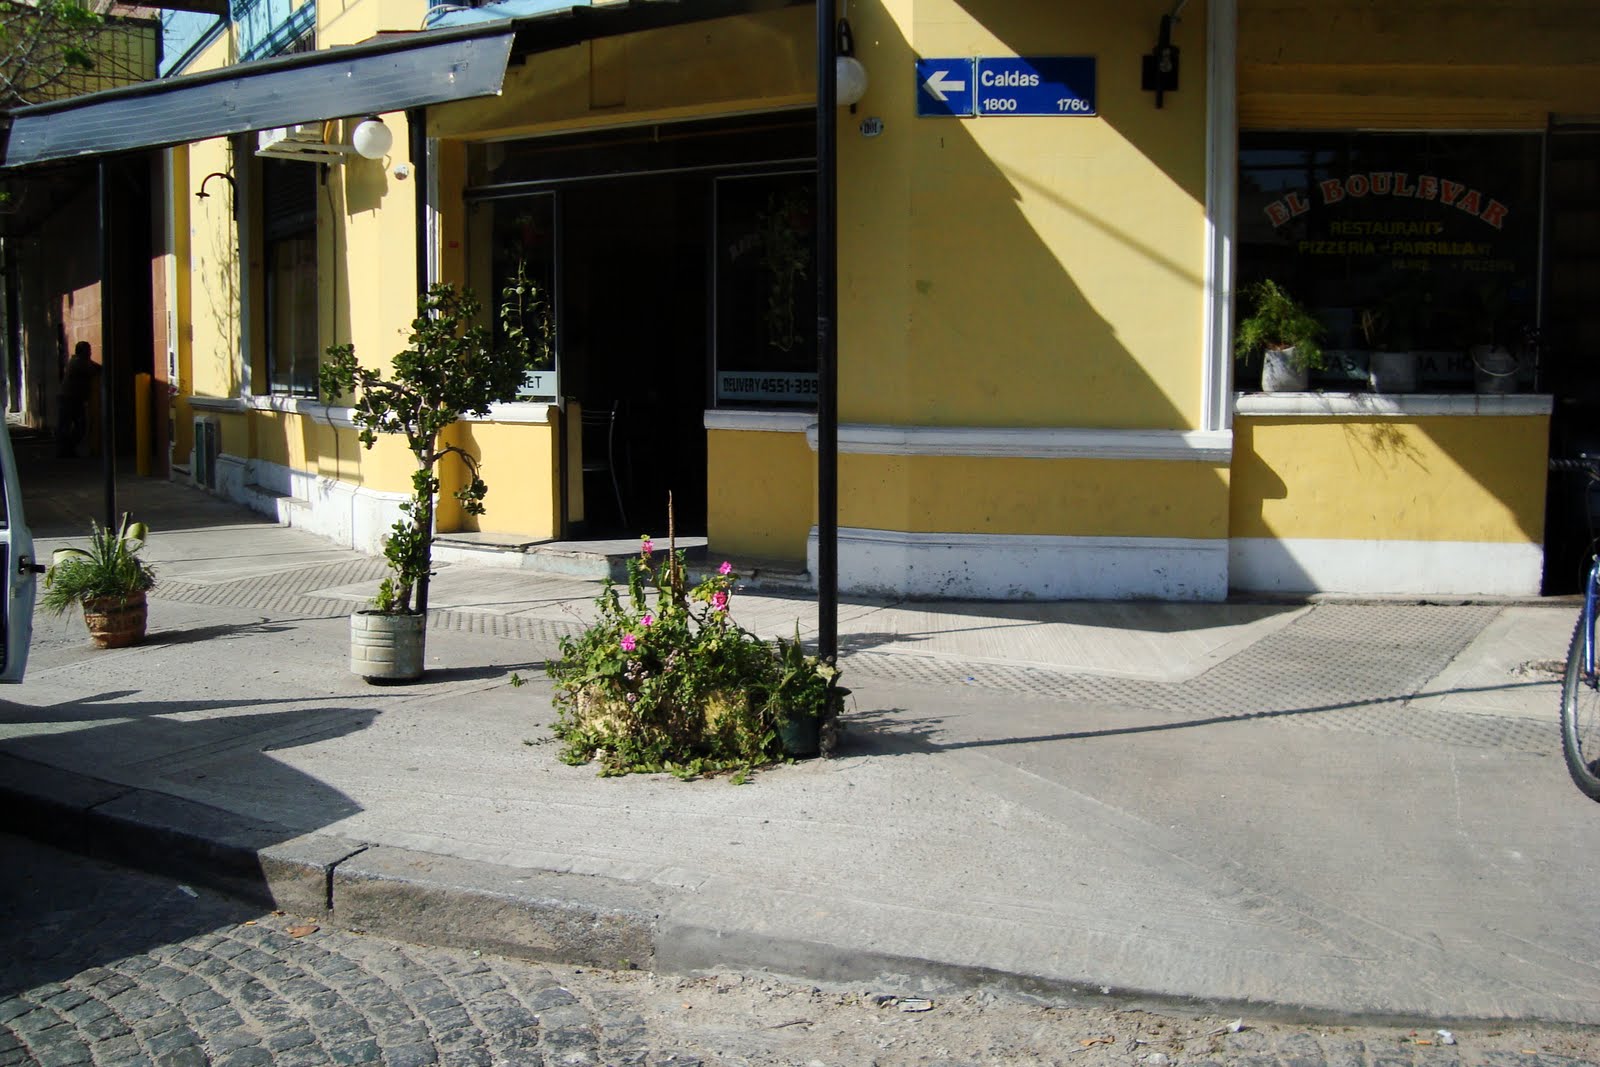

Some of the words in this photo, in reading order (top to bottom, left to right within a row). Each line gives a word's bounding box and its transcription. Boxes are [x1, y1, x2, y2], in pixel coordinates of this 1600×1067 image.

[981, 70, 1040, 87] Caldas
[983, 98, 1017, 111] 1800
[1057, 98, 1090, 111] 1760
[1263, 191, 1310, 228] EL
[1320, 171, 1510, 231] BOULEVAR
[1297, 240, 1375, 255] PIZZERIA
[1392, 241, 1474, 256] PARRILLA
[723, 377, 760, 393] DELIVERY
